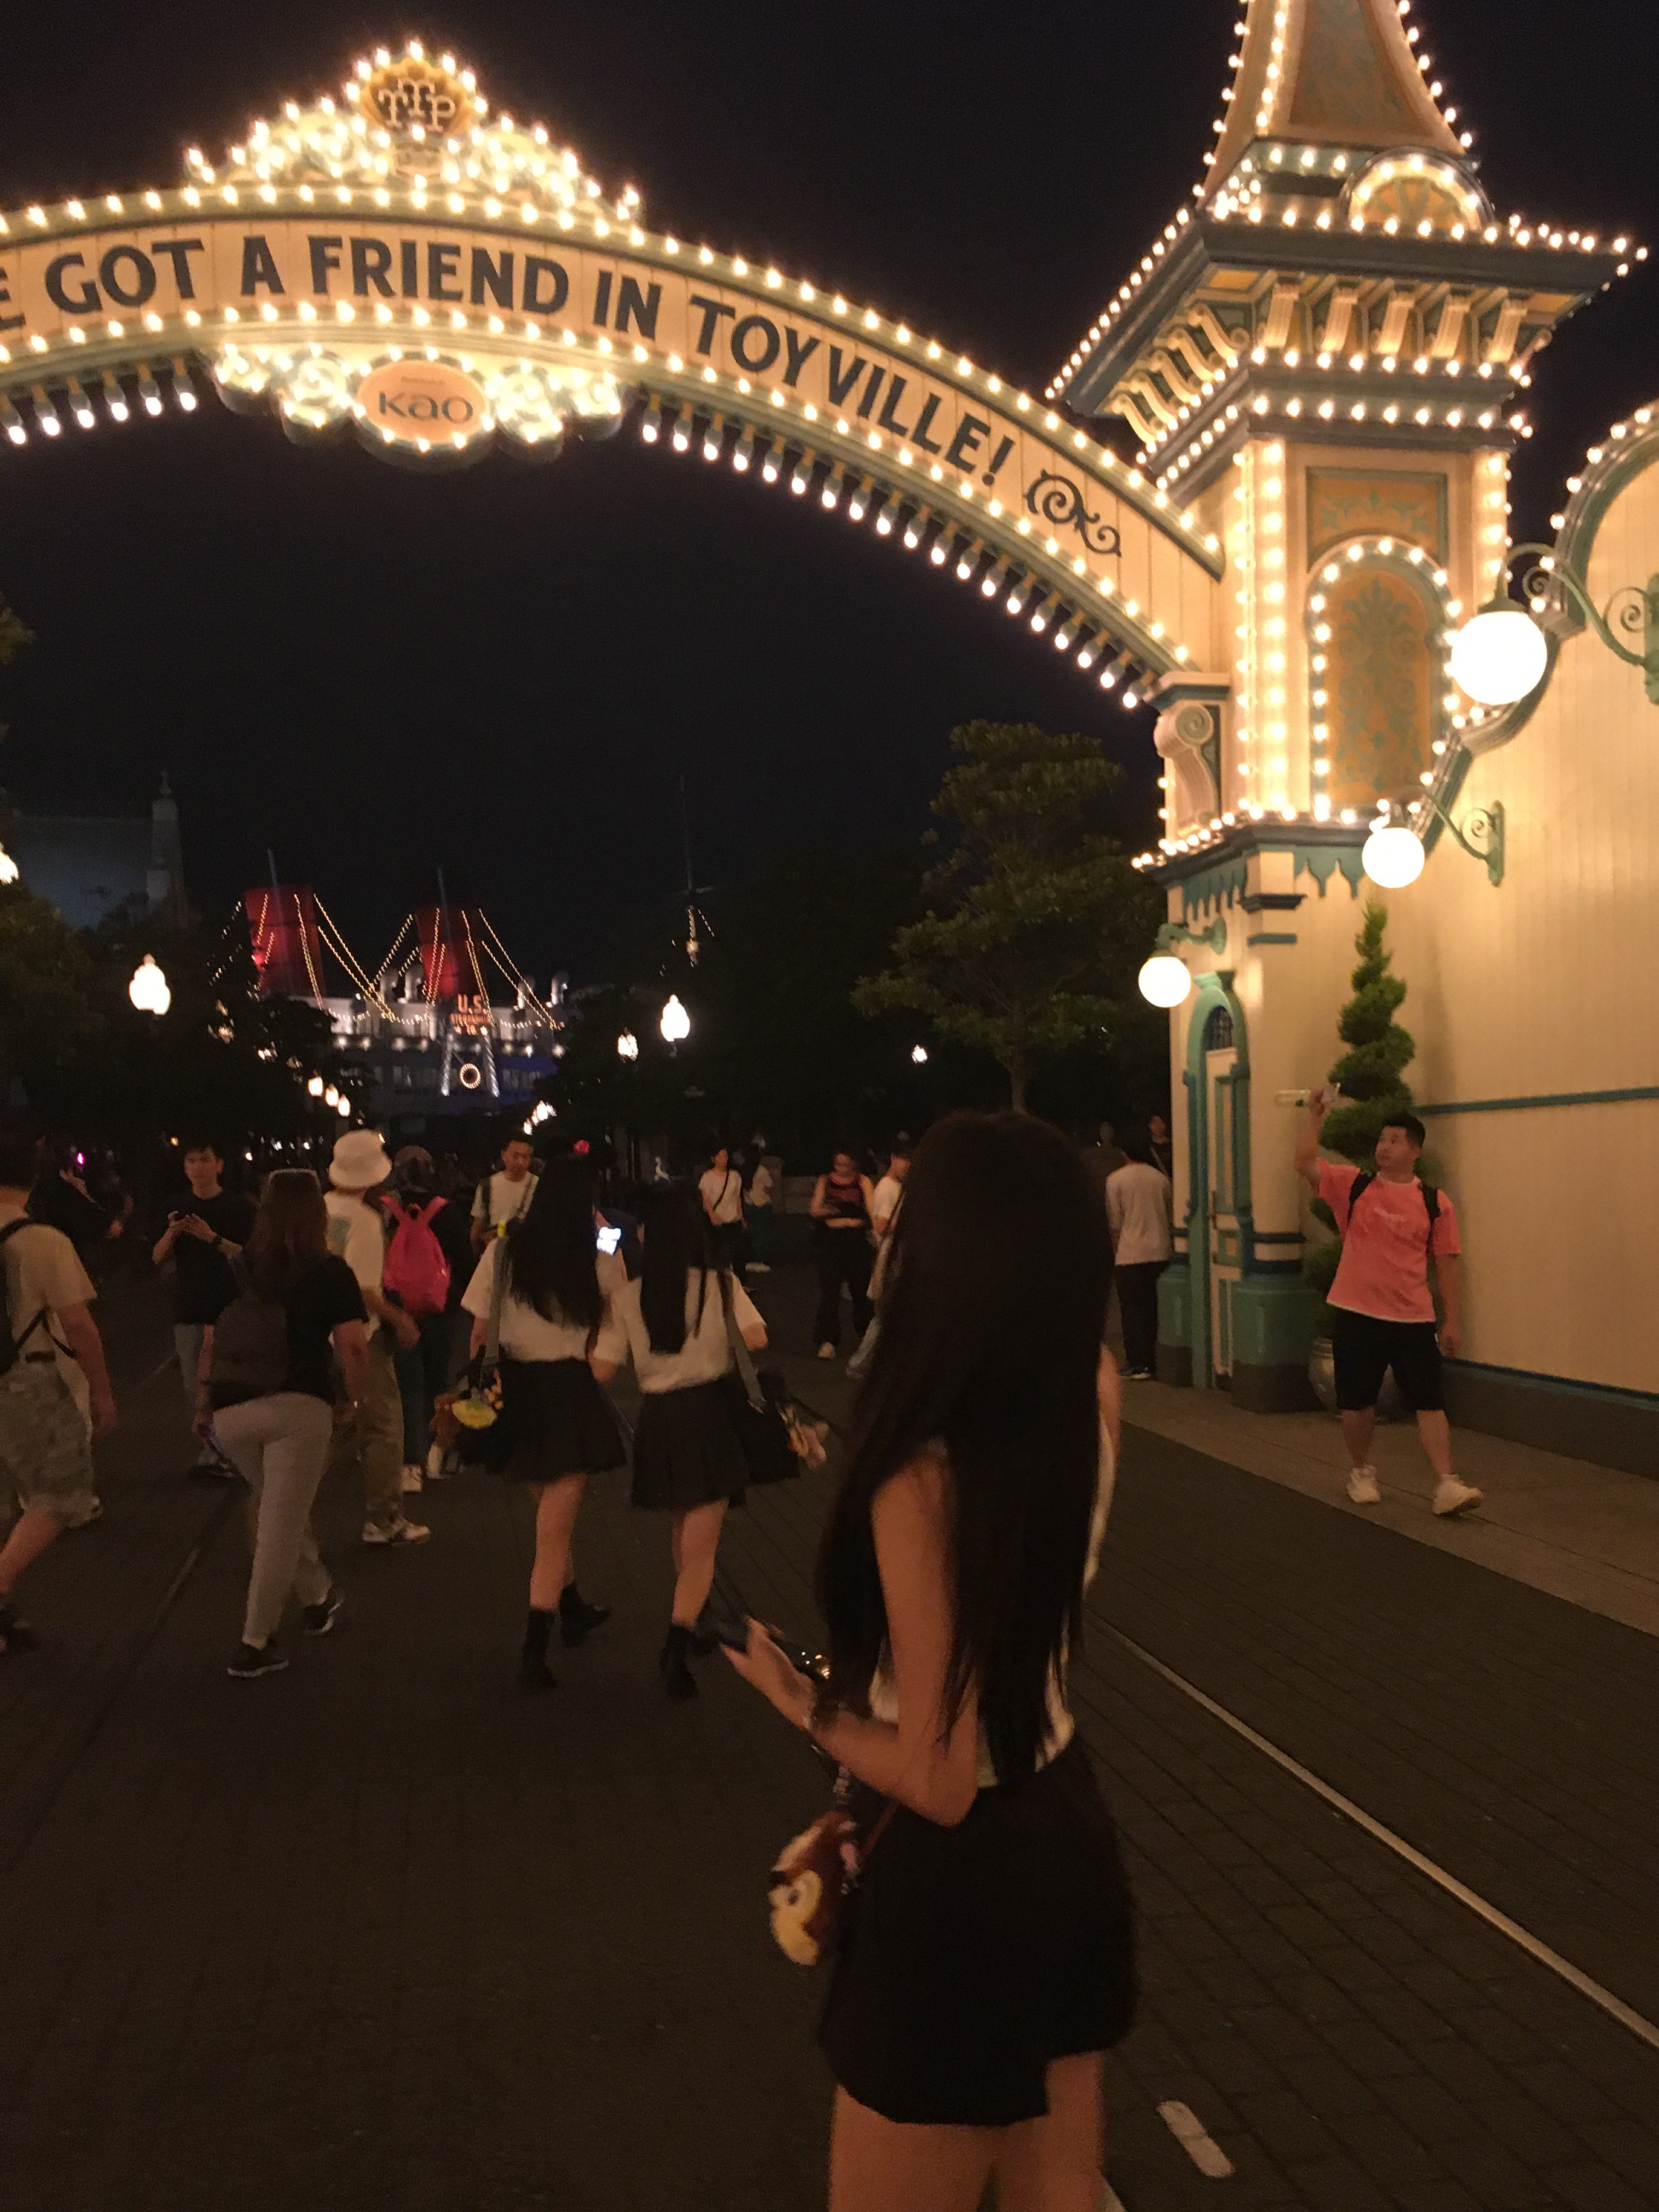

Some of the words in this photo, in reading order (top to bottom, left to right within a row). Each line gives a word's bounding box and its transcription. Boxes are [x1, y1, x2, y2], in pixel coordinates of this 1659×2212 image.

[44, 239, 204, 314] GOT
[241, 235, 285, 296] A
[308, 235, 569, 315] FRIEND
[592, 270, 662, 340] IN
[689, 294, 1015, 486] TOYVILLE!
